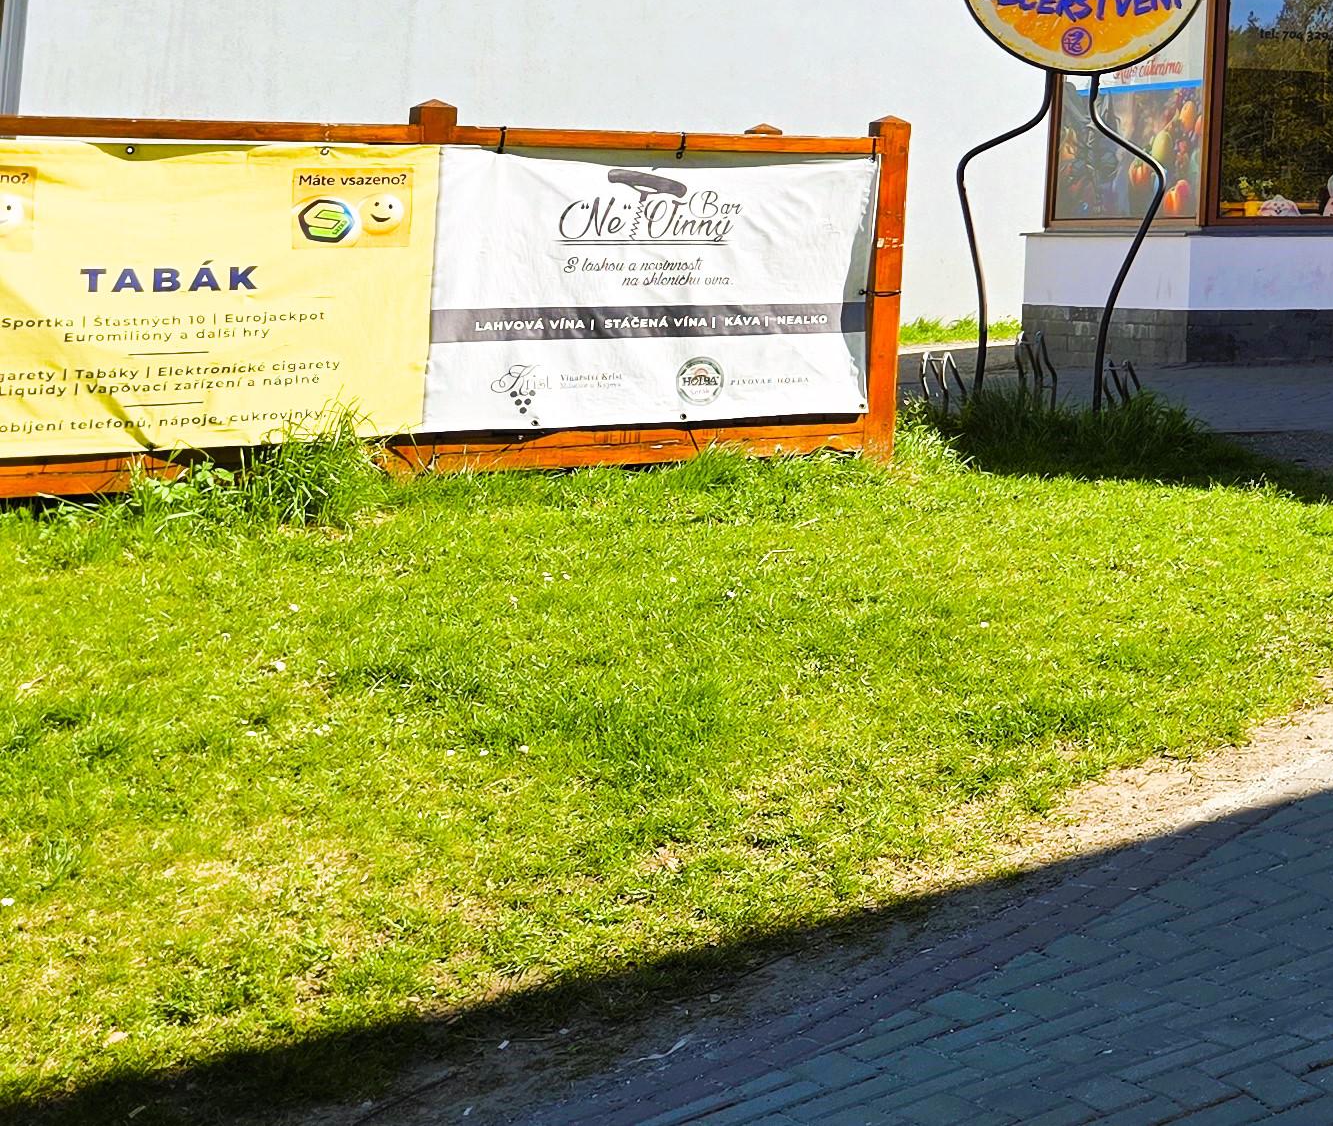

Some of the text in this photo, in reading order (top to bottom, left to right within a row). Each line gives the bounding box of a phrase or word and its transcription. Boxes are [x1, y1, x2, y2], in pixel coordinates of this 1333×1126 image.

[299, 174, 407, 186] Máte vsazeno?
[689, 191, 742, 218] Bar
[644, 199, 734, 242] Vinný
[564, 256, 578, 273] S
[628, 263, 636, 271] a
[81, 260, 259, 293] TABÁK
[622, 276, 639, 286] na
[2, 317, 74, 330] Sportka
[188, 315, 205, 325] 10
[225, 312, 325, 325] Eurojackpot
[475, 318, 545, 331] LAHVOVÁ
[549, 317, 585, 330] VÍNA
[604, 315, 668, 329] STÁČENÁ
[673, 315, 708, 327] VÍNA
[724, 314, 760, 326] KÁVA
[776, 314, 828, 325] NEALKO
[180, 332, 188, 340] a
[243, 327, 270, 339] hry
[75, 368, 139, 380] Tabáky
[159, 362, 266, 377] Elektronické
[272, 360, 340, 372] cigarety
[0, 385, 66, 397] Liquidy
[174, 377, 242, 391] zařízení
[247, 378, 255, 387] a
[263, 374, 320, 387] náplně
[682, 374, 719, 386] HOLBA
